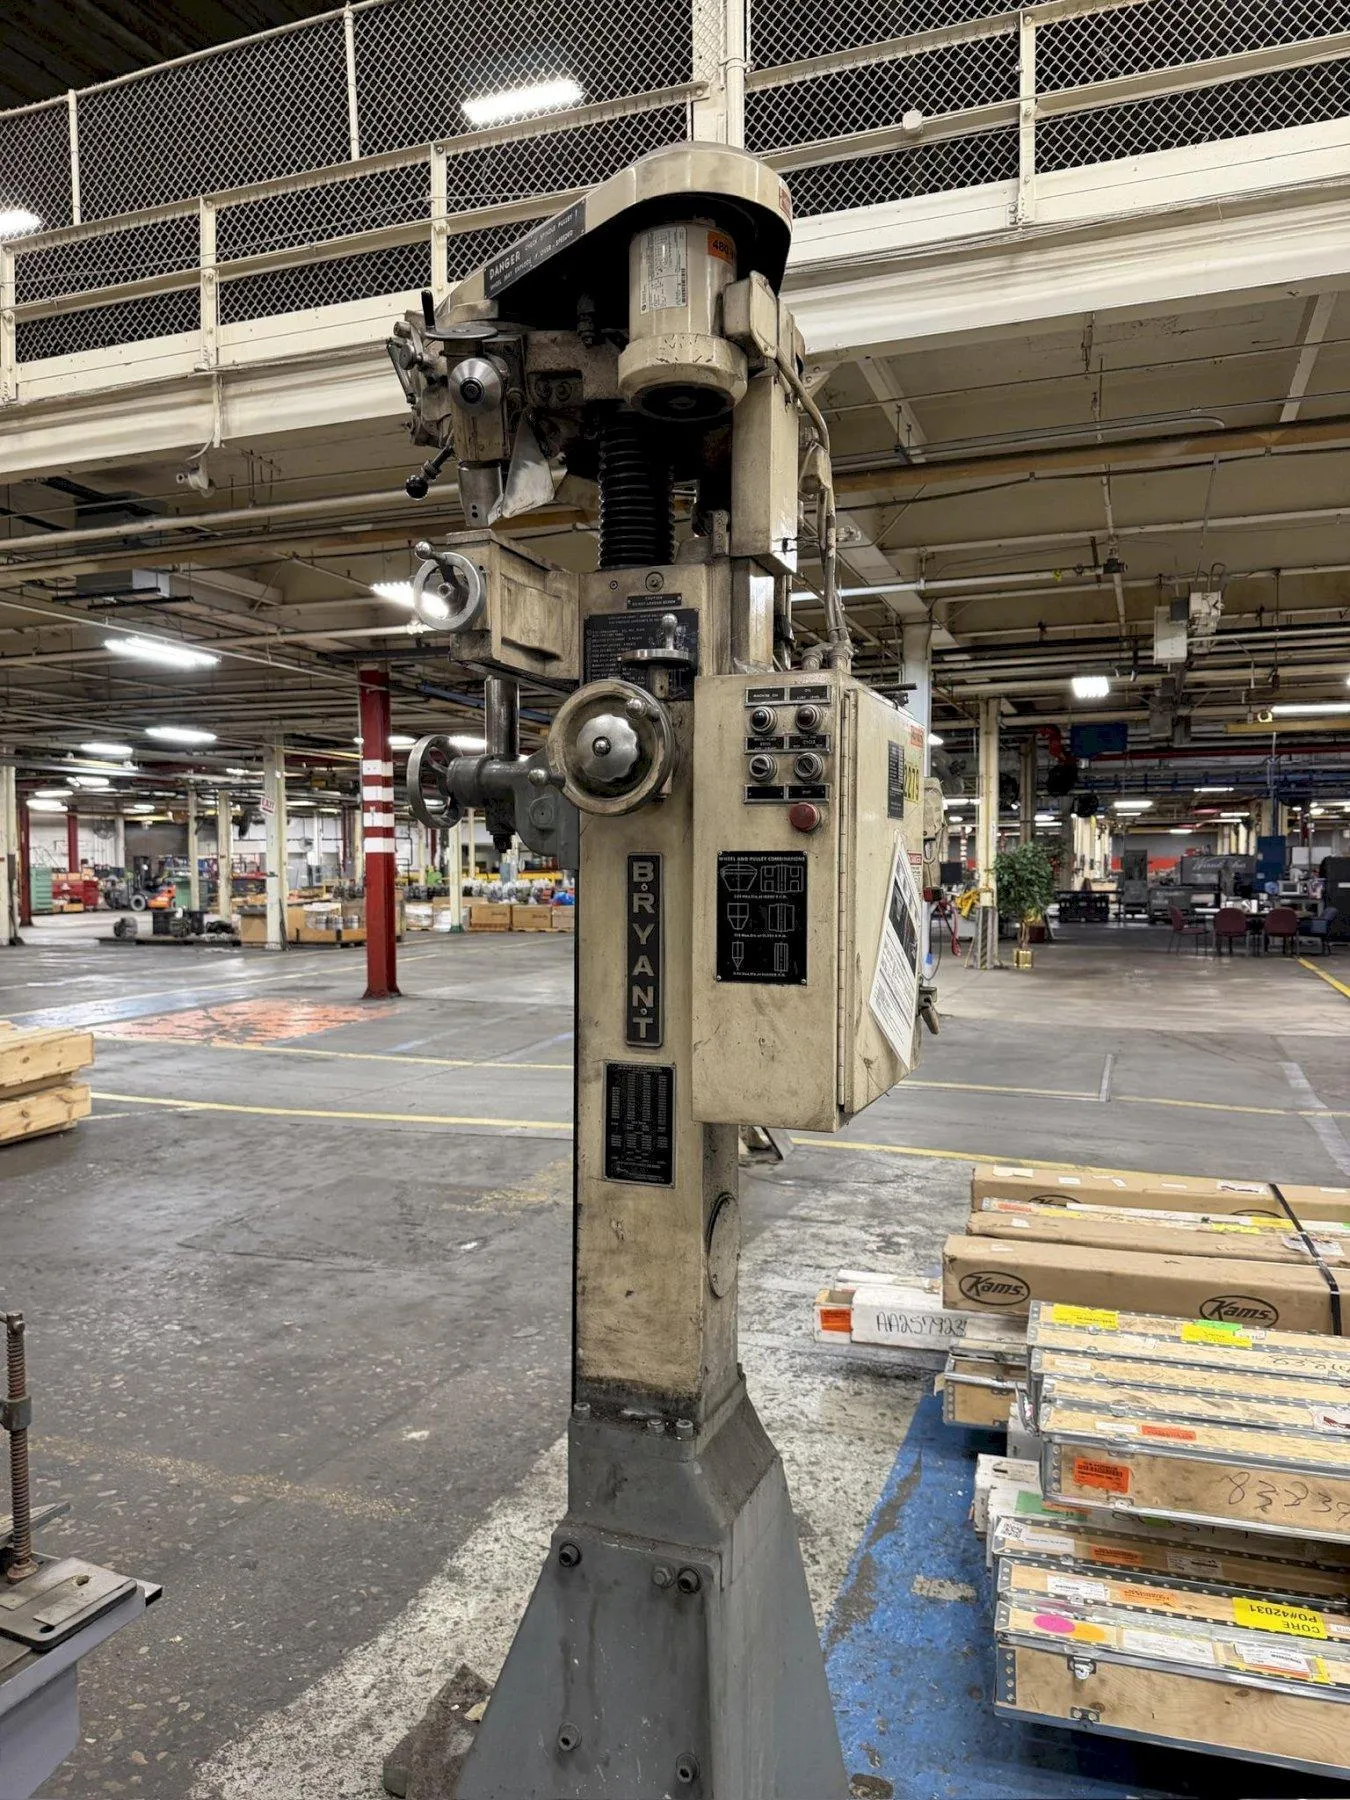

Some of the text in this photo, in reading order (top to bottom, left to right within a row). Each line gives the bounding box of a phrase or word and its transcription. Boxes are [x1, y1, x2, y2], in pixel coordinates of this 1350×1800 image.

[489, 251, 521, 280] DANGER
[632, 860, 655, 1039] BRYANT
[966, 1274, 1023, 1297] Kams
[1208, 1299, 1271, 1321] Kams
